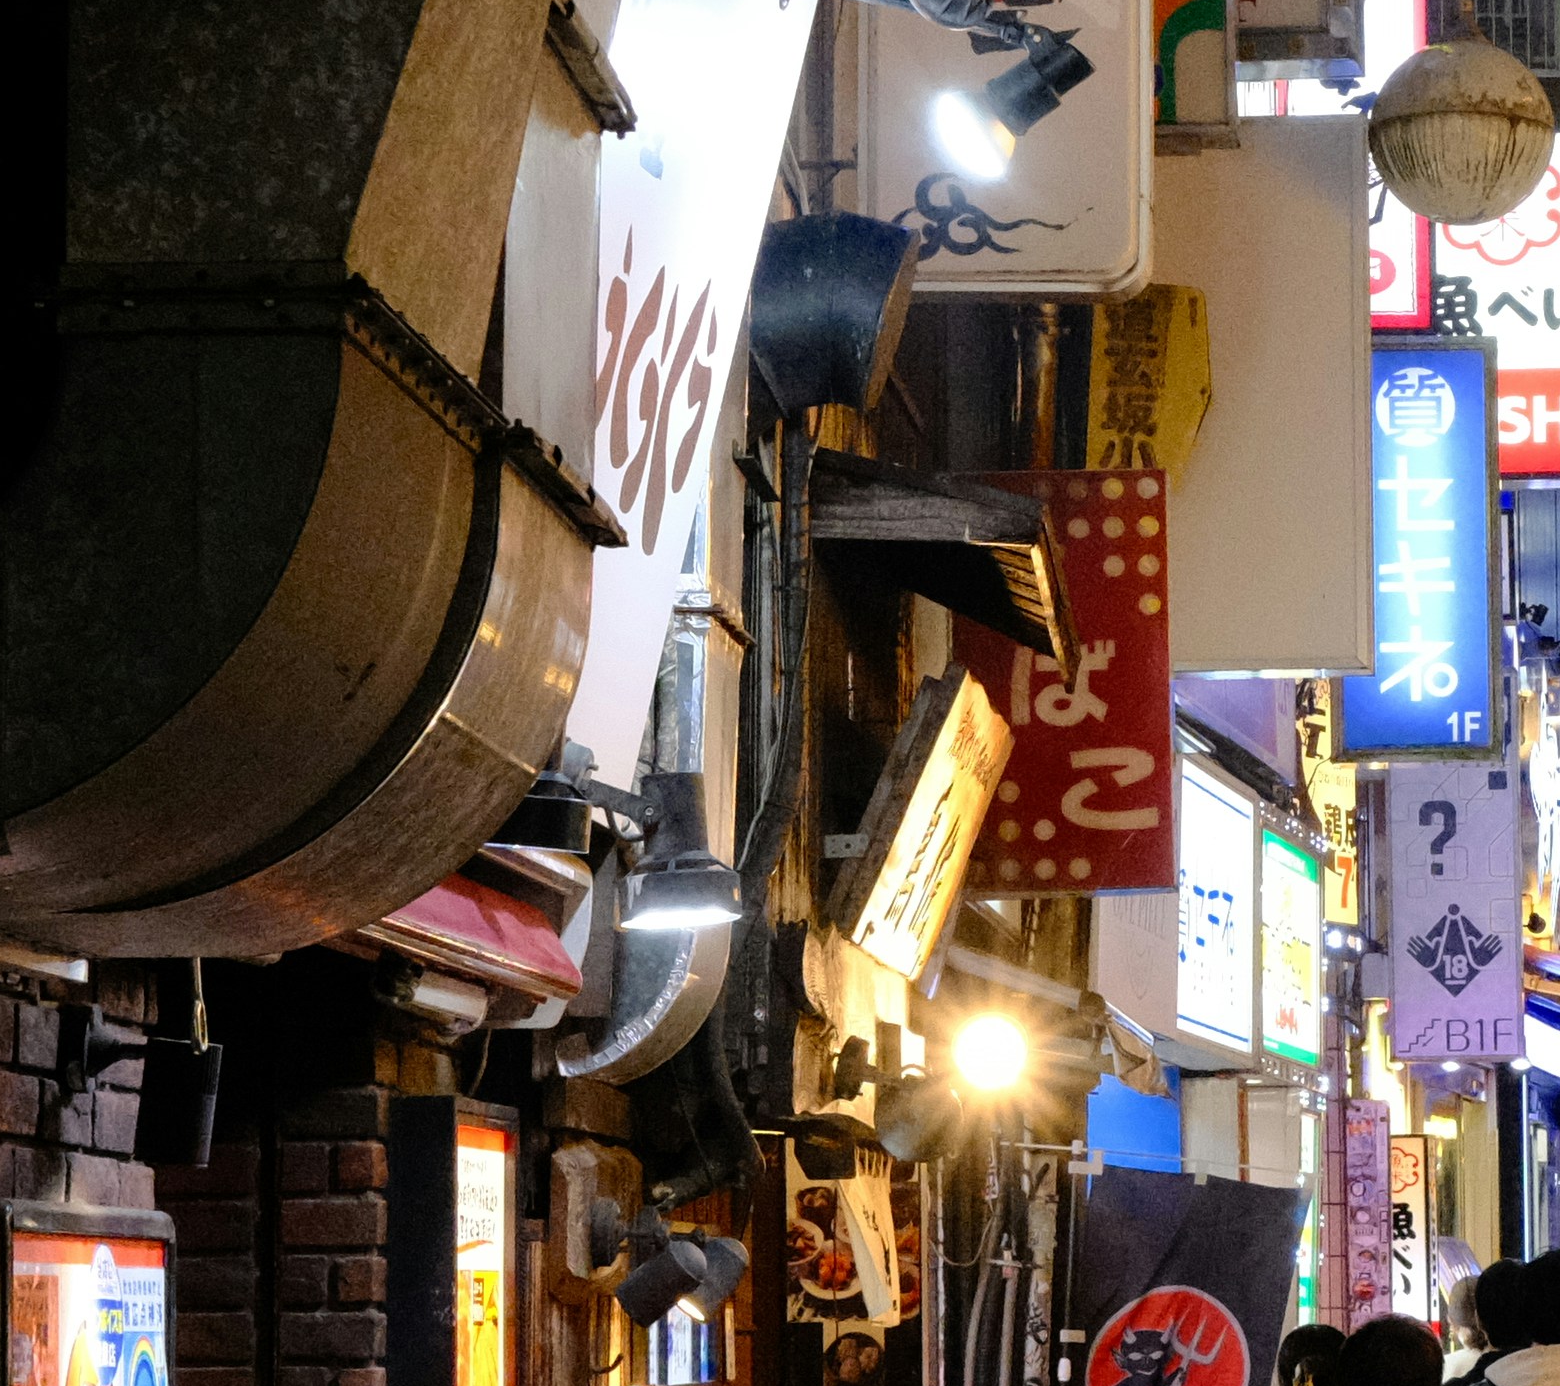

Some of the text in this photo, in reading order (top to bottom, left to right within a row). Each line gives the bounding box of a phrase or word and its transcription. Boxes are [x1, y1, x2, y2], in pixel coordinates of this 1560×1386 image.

[1377, 455, 1459, 702] セキネ
[1446, 712, 1481, 743] 1F
[1442, 953, 1468, 979] 18
[1446, 1017, 1514, 1052] B1F
